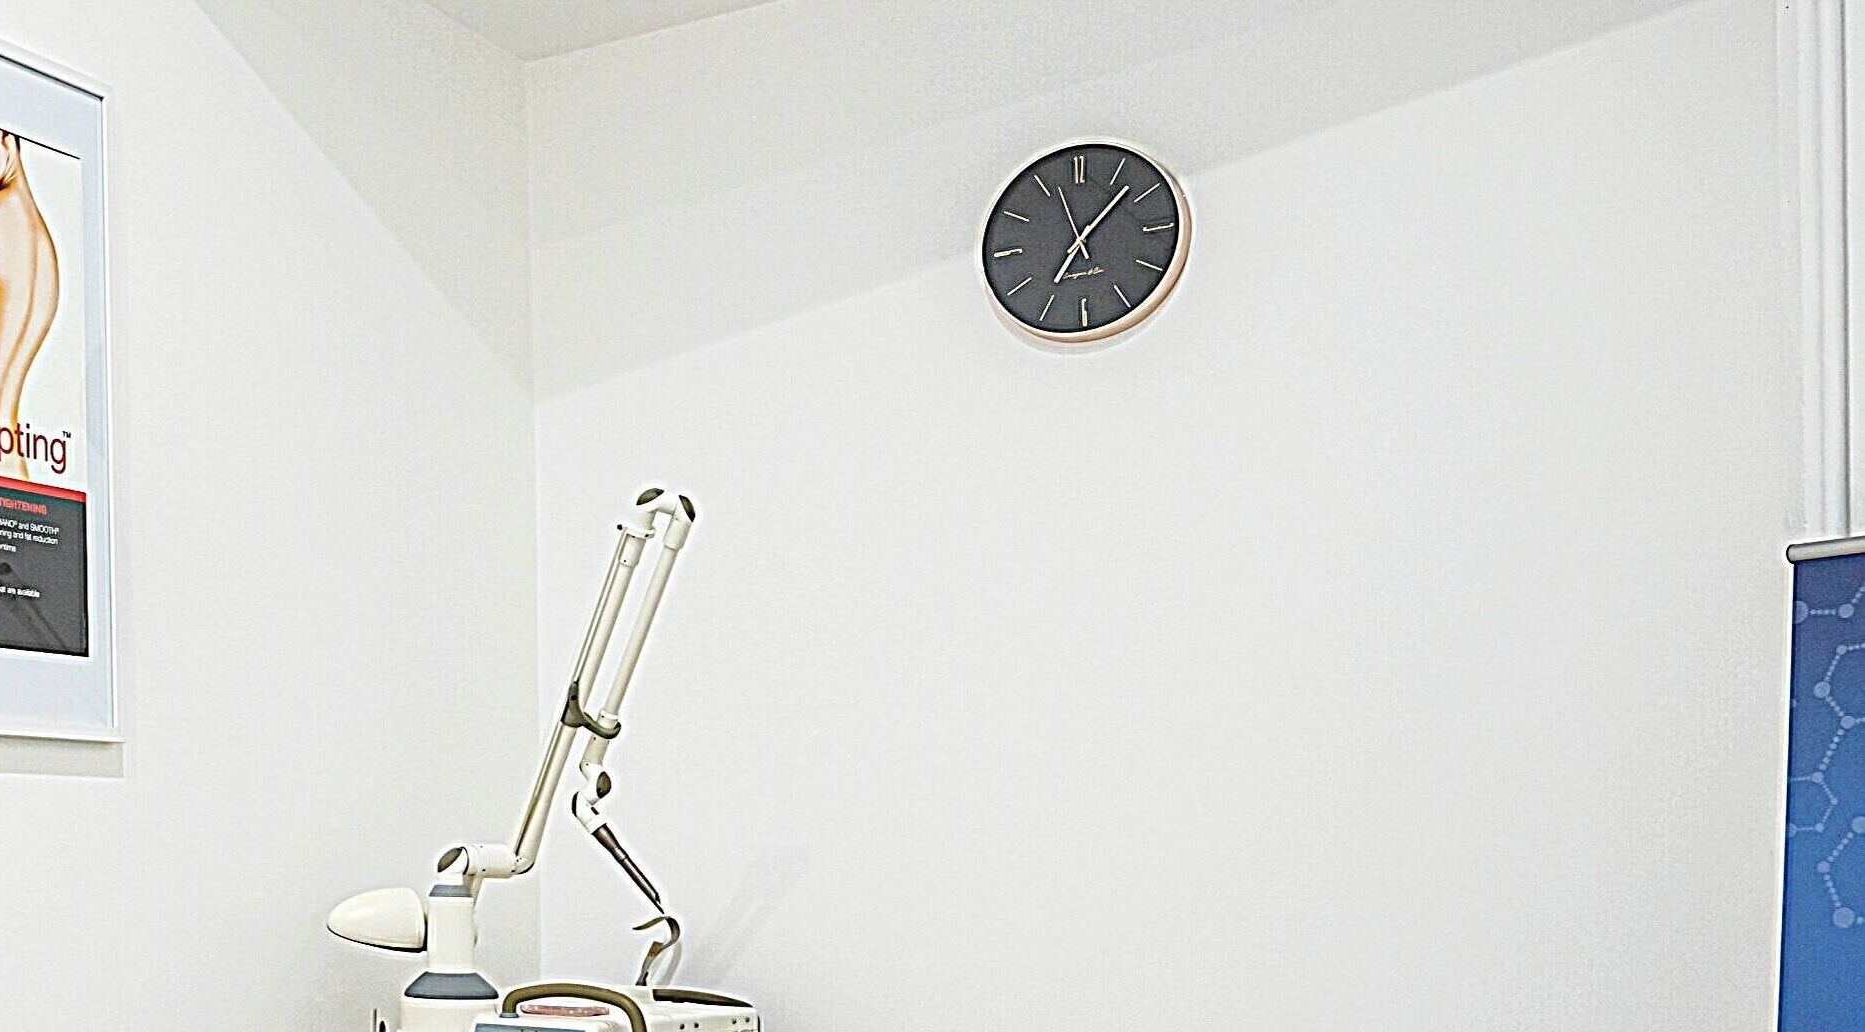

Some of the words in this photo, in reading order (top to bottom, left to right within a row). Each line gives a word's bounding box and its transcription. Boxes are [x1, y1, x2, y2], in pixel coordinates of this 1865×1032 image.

[18, 522, 29, 531] and
[13, 531, 24, 540] and
[32, 534, 59, 546] reduction
[6, 587, 16, 595] are
